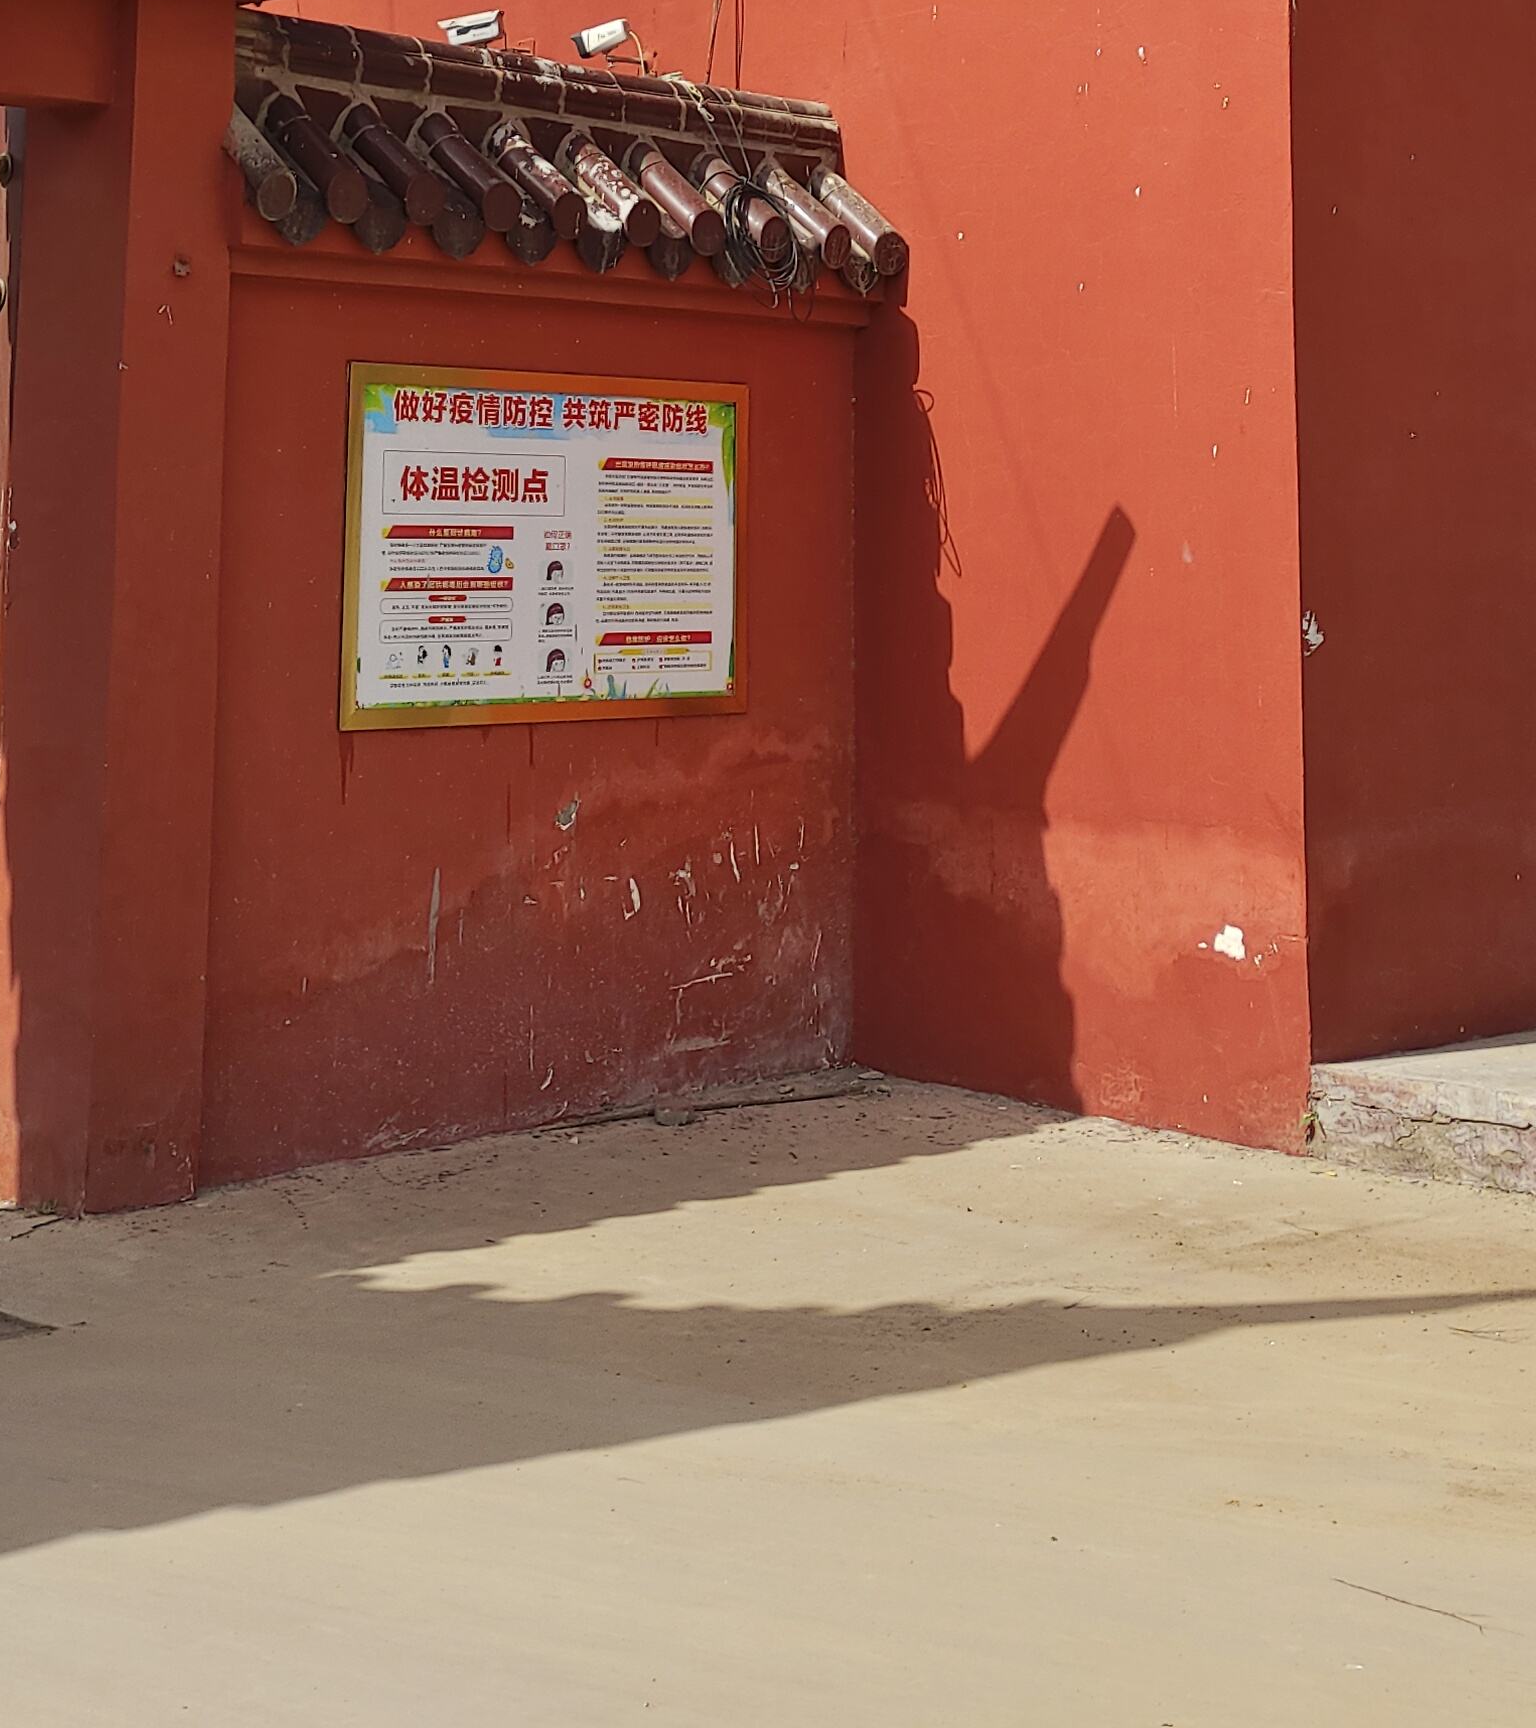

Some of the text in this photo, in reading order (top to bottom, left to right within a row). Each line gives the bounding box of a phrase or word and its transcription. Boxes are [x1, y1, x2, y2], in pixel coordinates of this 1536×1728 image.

[394, 389, 708, 435] 做好疫情防控 共筑严密防线
[400, 465, 550, 504] 体温检测点
